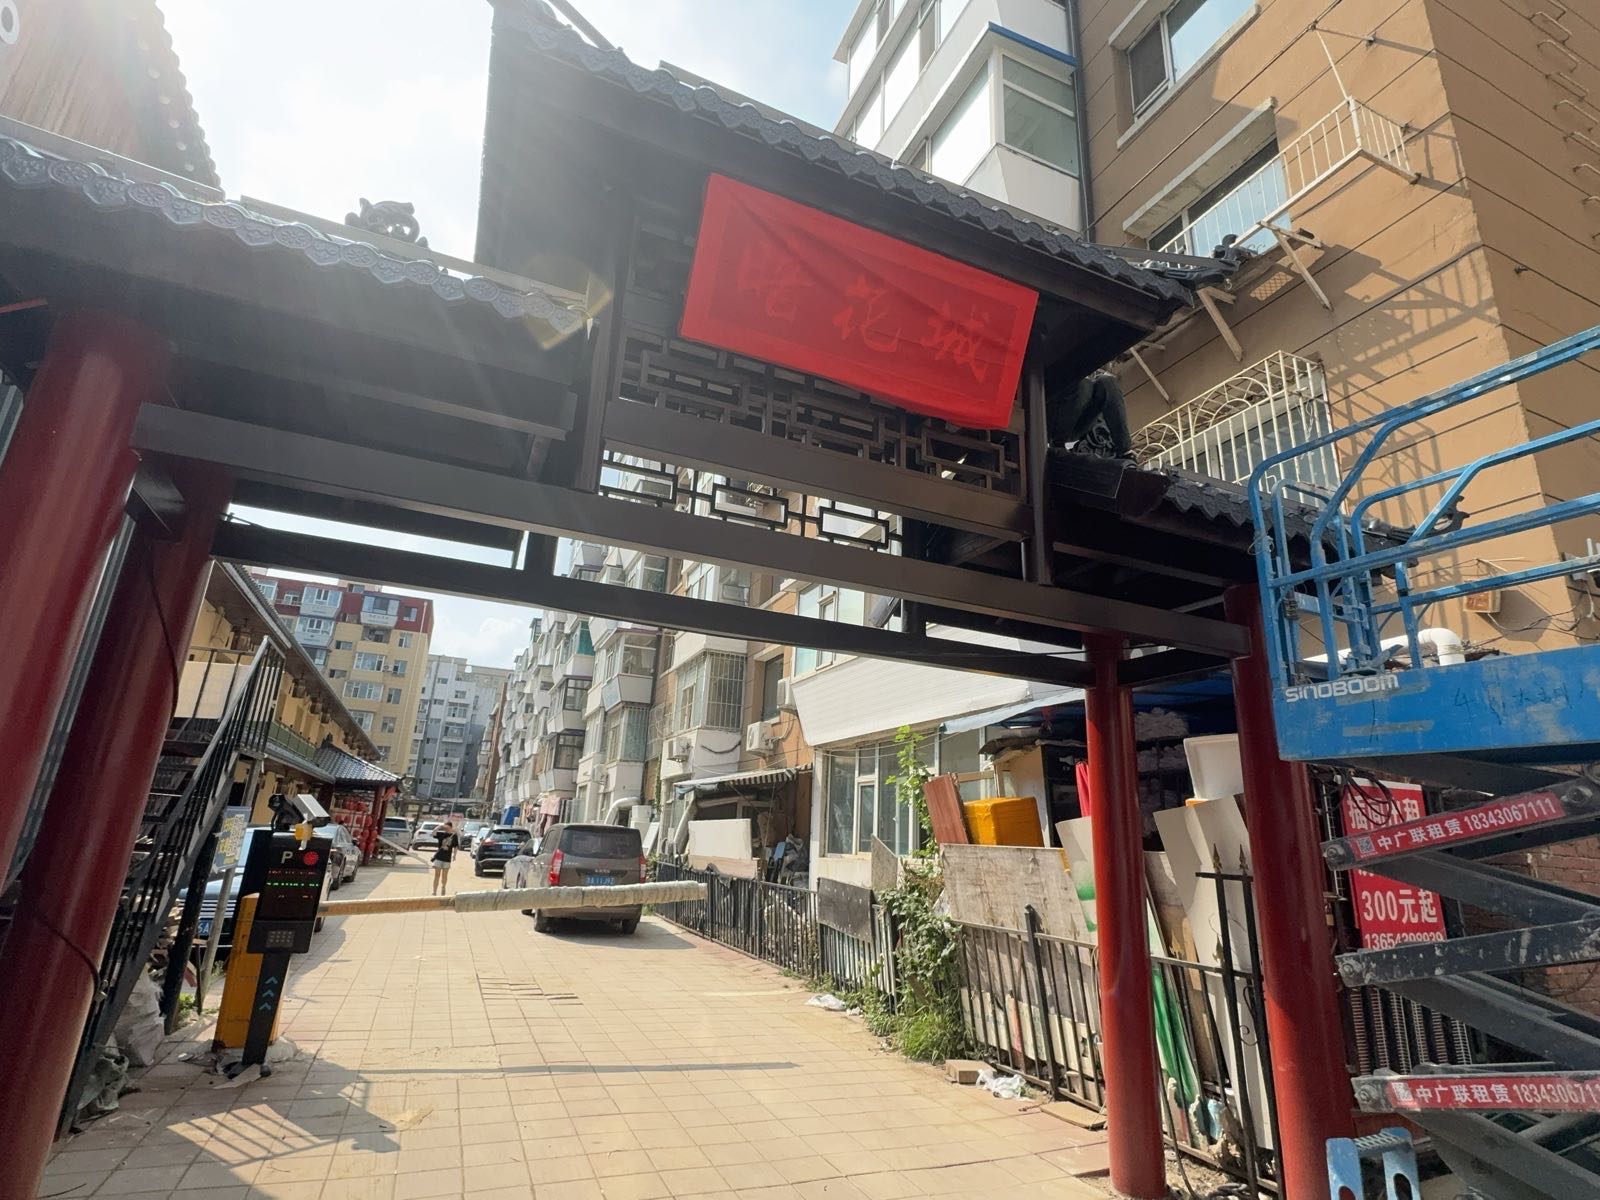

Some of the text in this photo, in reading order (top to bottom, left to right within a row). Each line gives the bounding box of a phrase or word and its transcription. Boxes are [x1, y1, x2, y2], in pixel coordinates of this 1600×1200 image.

[1377, 797, 1556, 851] 中广联租赁 18343067111
[1361, 888, 1438, 924] 300元起
[1415, 1083, 1512, 1104] 中广联租赁
